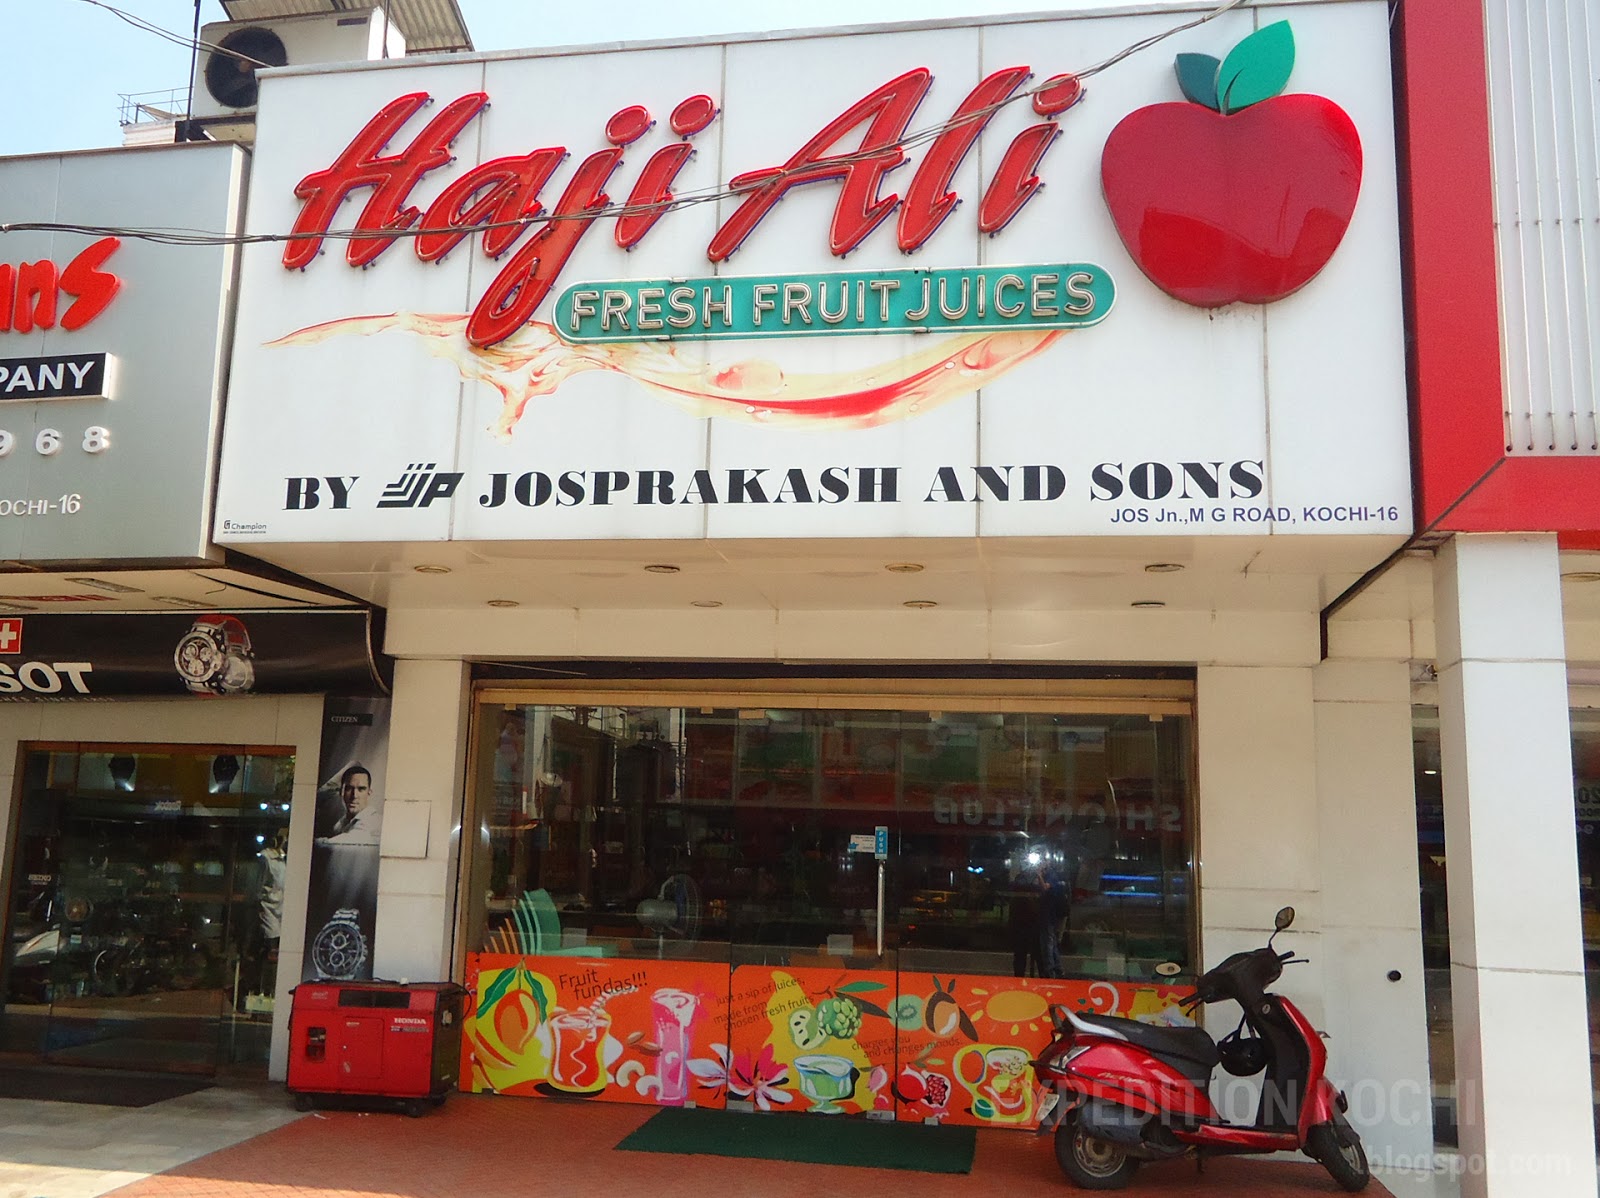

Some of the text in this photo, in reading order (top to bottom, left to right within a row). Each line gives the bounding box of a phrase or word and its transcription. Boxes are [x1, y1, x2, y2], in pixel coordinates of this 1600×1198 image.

[282, 66, 1084, 348] Haji Ali
[0, 236, 121, 334] ns
[570, 272, 1096, 331] FRESH FRUIT JUICES
[282, 476, 360, 510] BY
[479, 467, 902, 507] JOSPRAKASH
[924, 465, 1066, 503] AND
[1090, 460, 1265, 501] SONS
[1110, 508, 1149, 523] JOS
[1211, 508, 1226, 522] G
[1232, 507, 1296, 524] ROAD,
[1303, 506, 1399, 522] KOCHI-16
[231, 522, 267, 531] Champion
[559, 969, 598, 990] Fruit
[574, 971, 648, 1001] fundas!!!
[745, 987, 760, 999] sip
[761, 984, 773, 993] of
[743, 1001, 768, 1015] from
[761, 1001, 787, 1018] fresh
[787, 995, 815, 1010] fruits
[393, 1017, 427, 1025] HONDA
